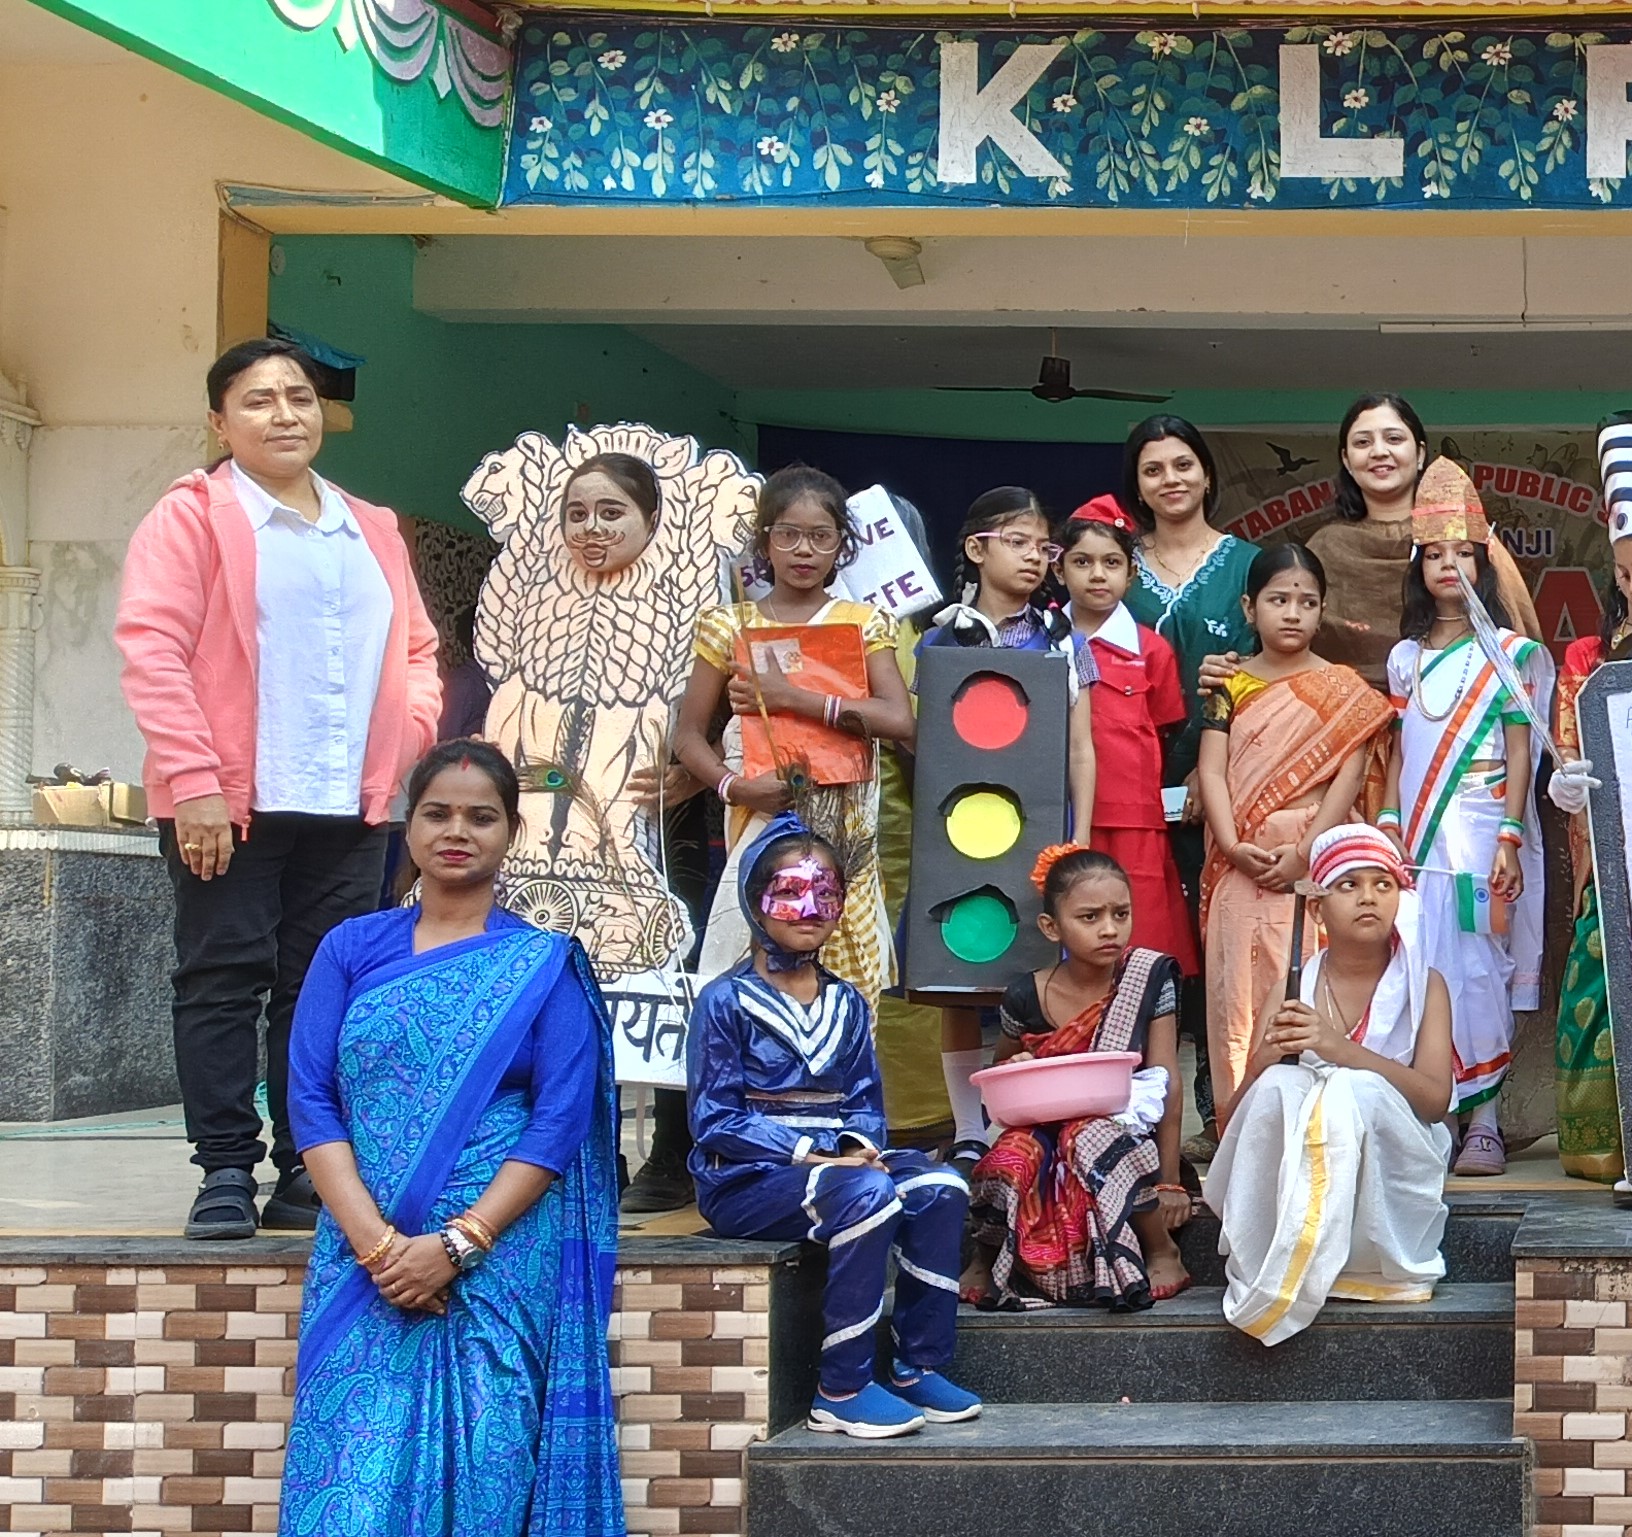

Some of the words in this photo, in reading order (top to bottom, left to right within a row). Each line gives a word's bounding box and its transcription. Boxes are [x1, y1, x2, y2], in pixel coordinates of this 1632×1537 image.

[939, 41, 1070, 184] K
[1278, 44, 1405, 178] L
[1473, 464, 1594, 514] PUBLIC
